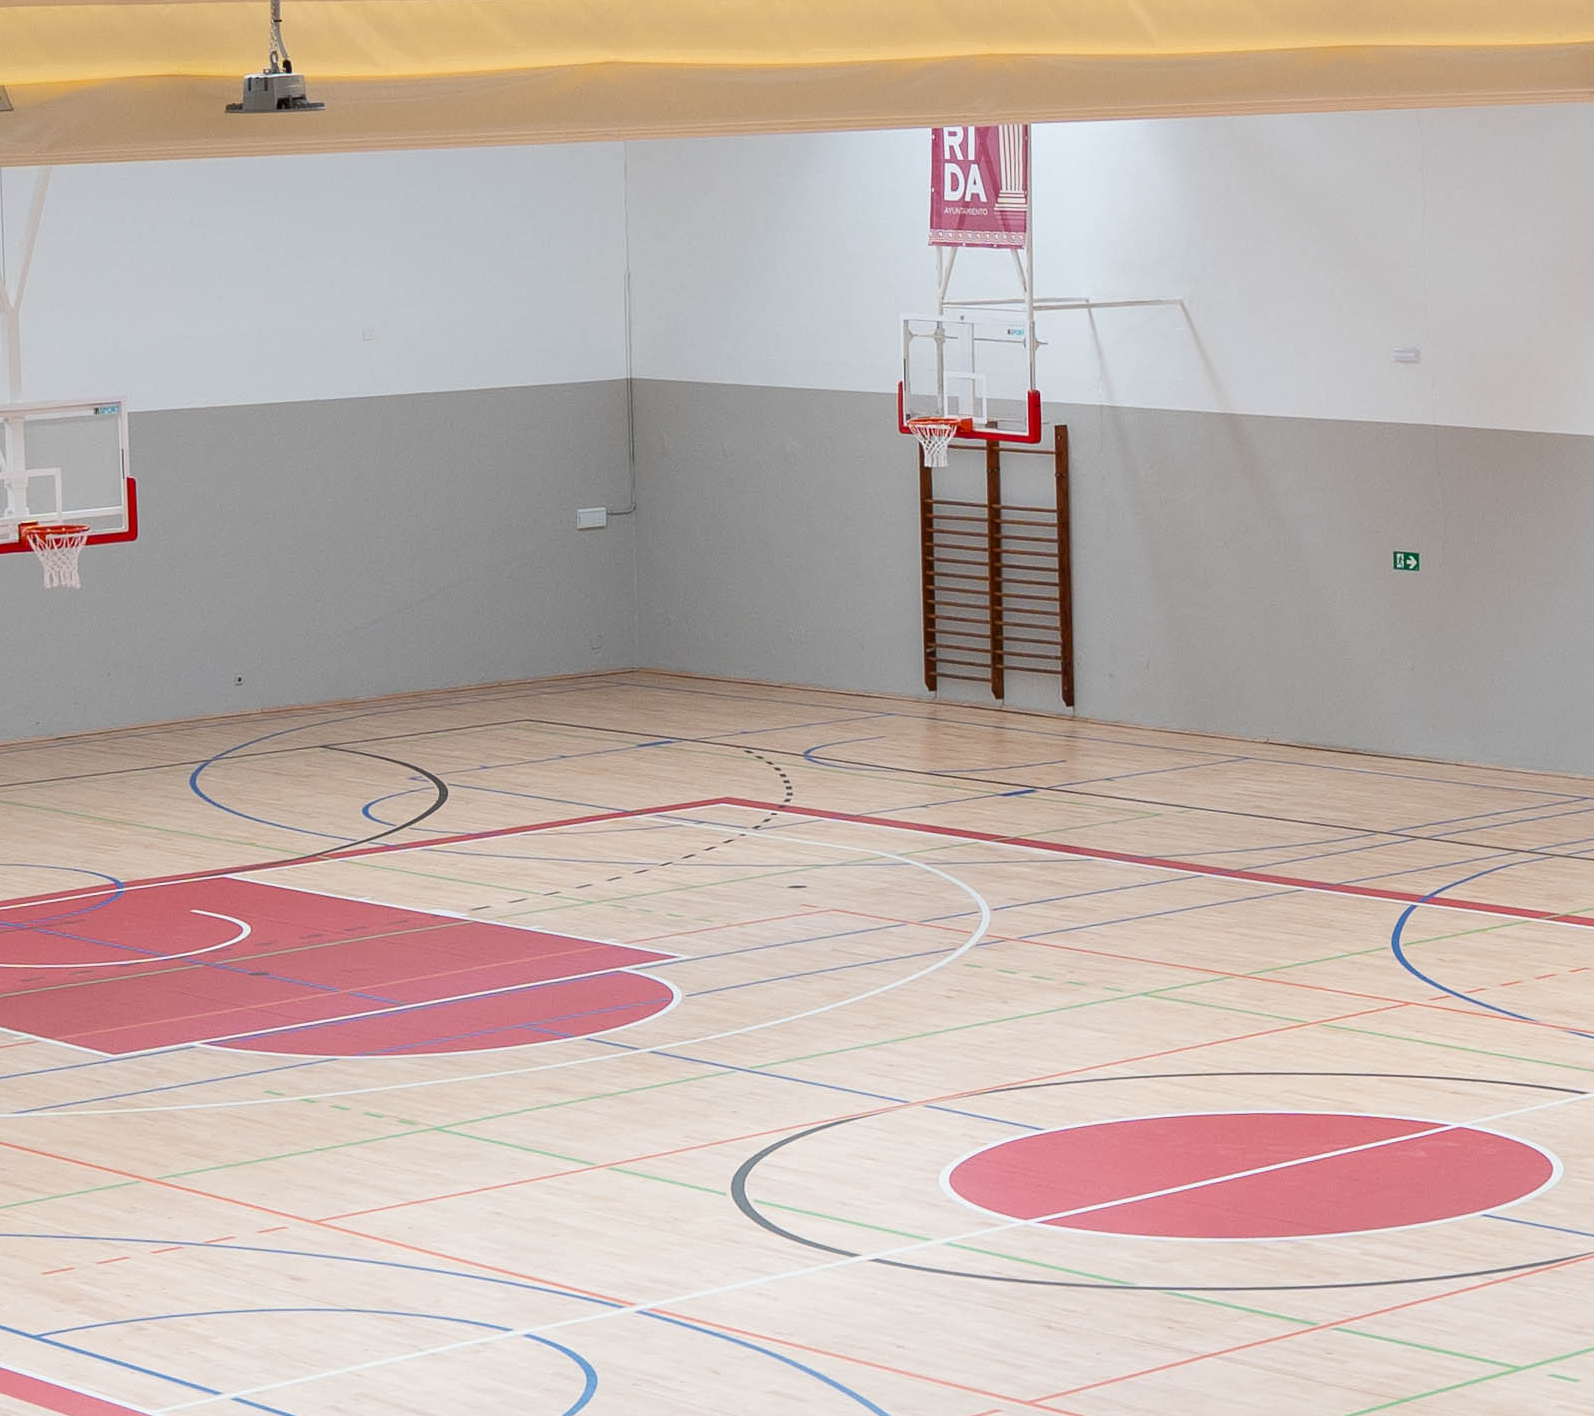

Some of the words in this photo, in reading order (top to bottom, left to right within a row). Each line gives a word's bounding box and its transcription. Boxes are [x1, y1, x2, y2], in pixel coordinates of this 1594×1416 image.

[943, 126, 975, 161] RI
[944, 163, 987, 202] DA
[943, 207, 989, 215] AYUNTAMIENTO
